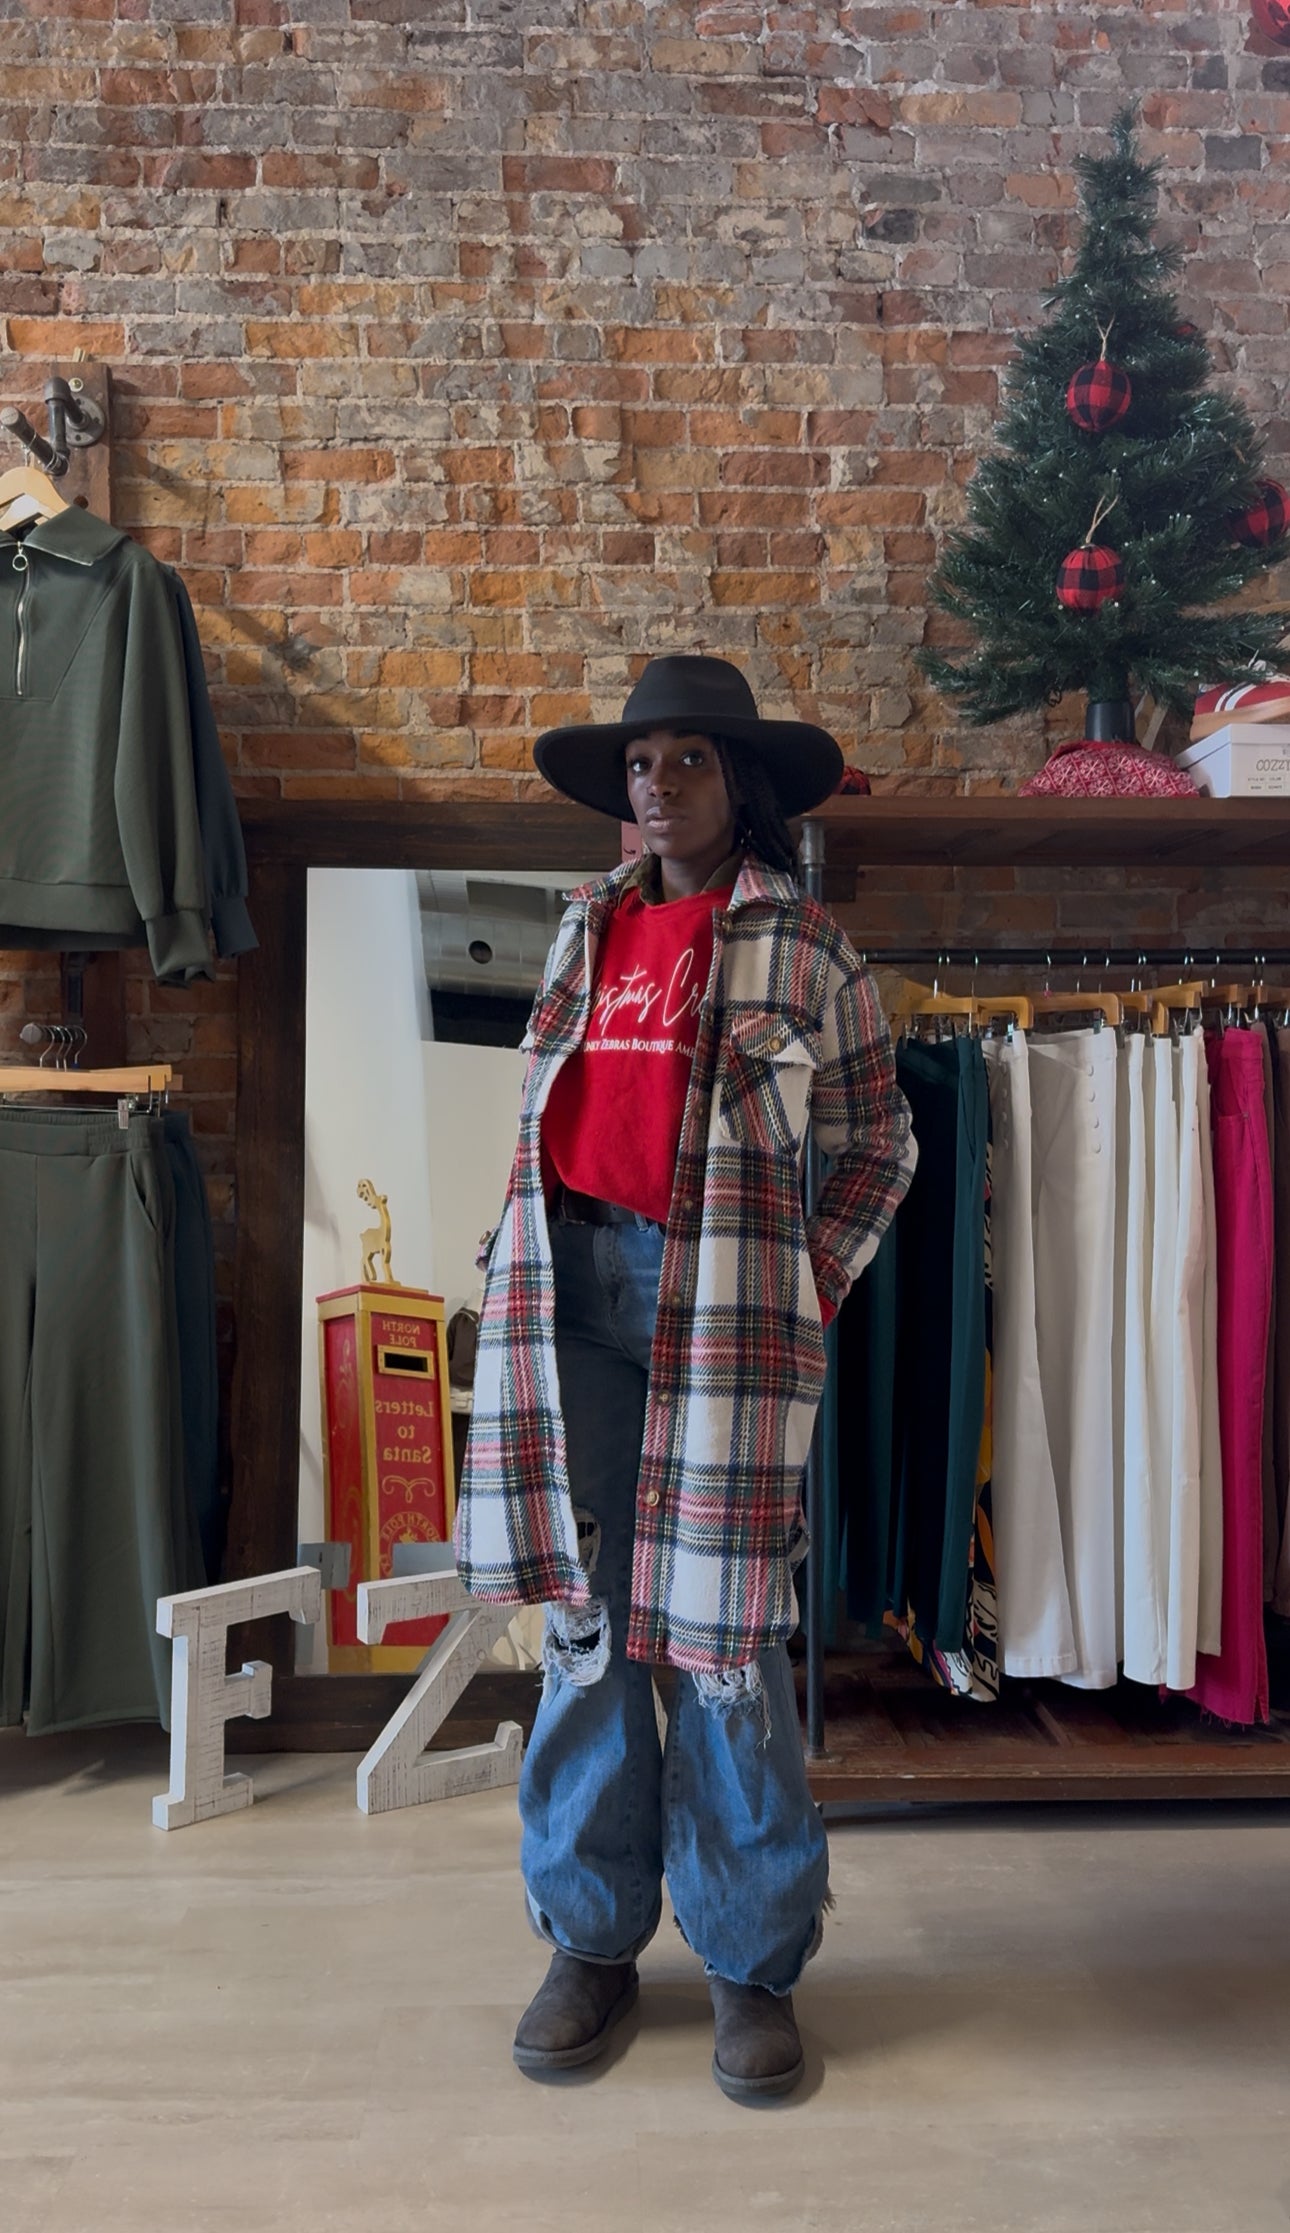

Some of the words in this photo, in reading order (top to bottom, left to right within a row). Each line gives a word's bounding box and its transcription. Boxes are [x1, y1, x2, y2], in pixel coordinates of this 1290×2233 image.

[584, 1040, 600, 1052] NKY
[601, 1038, 631, 1051] ZEBRAS
[632, 1038, 675, 1054] BOUTIQUE
